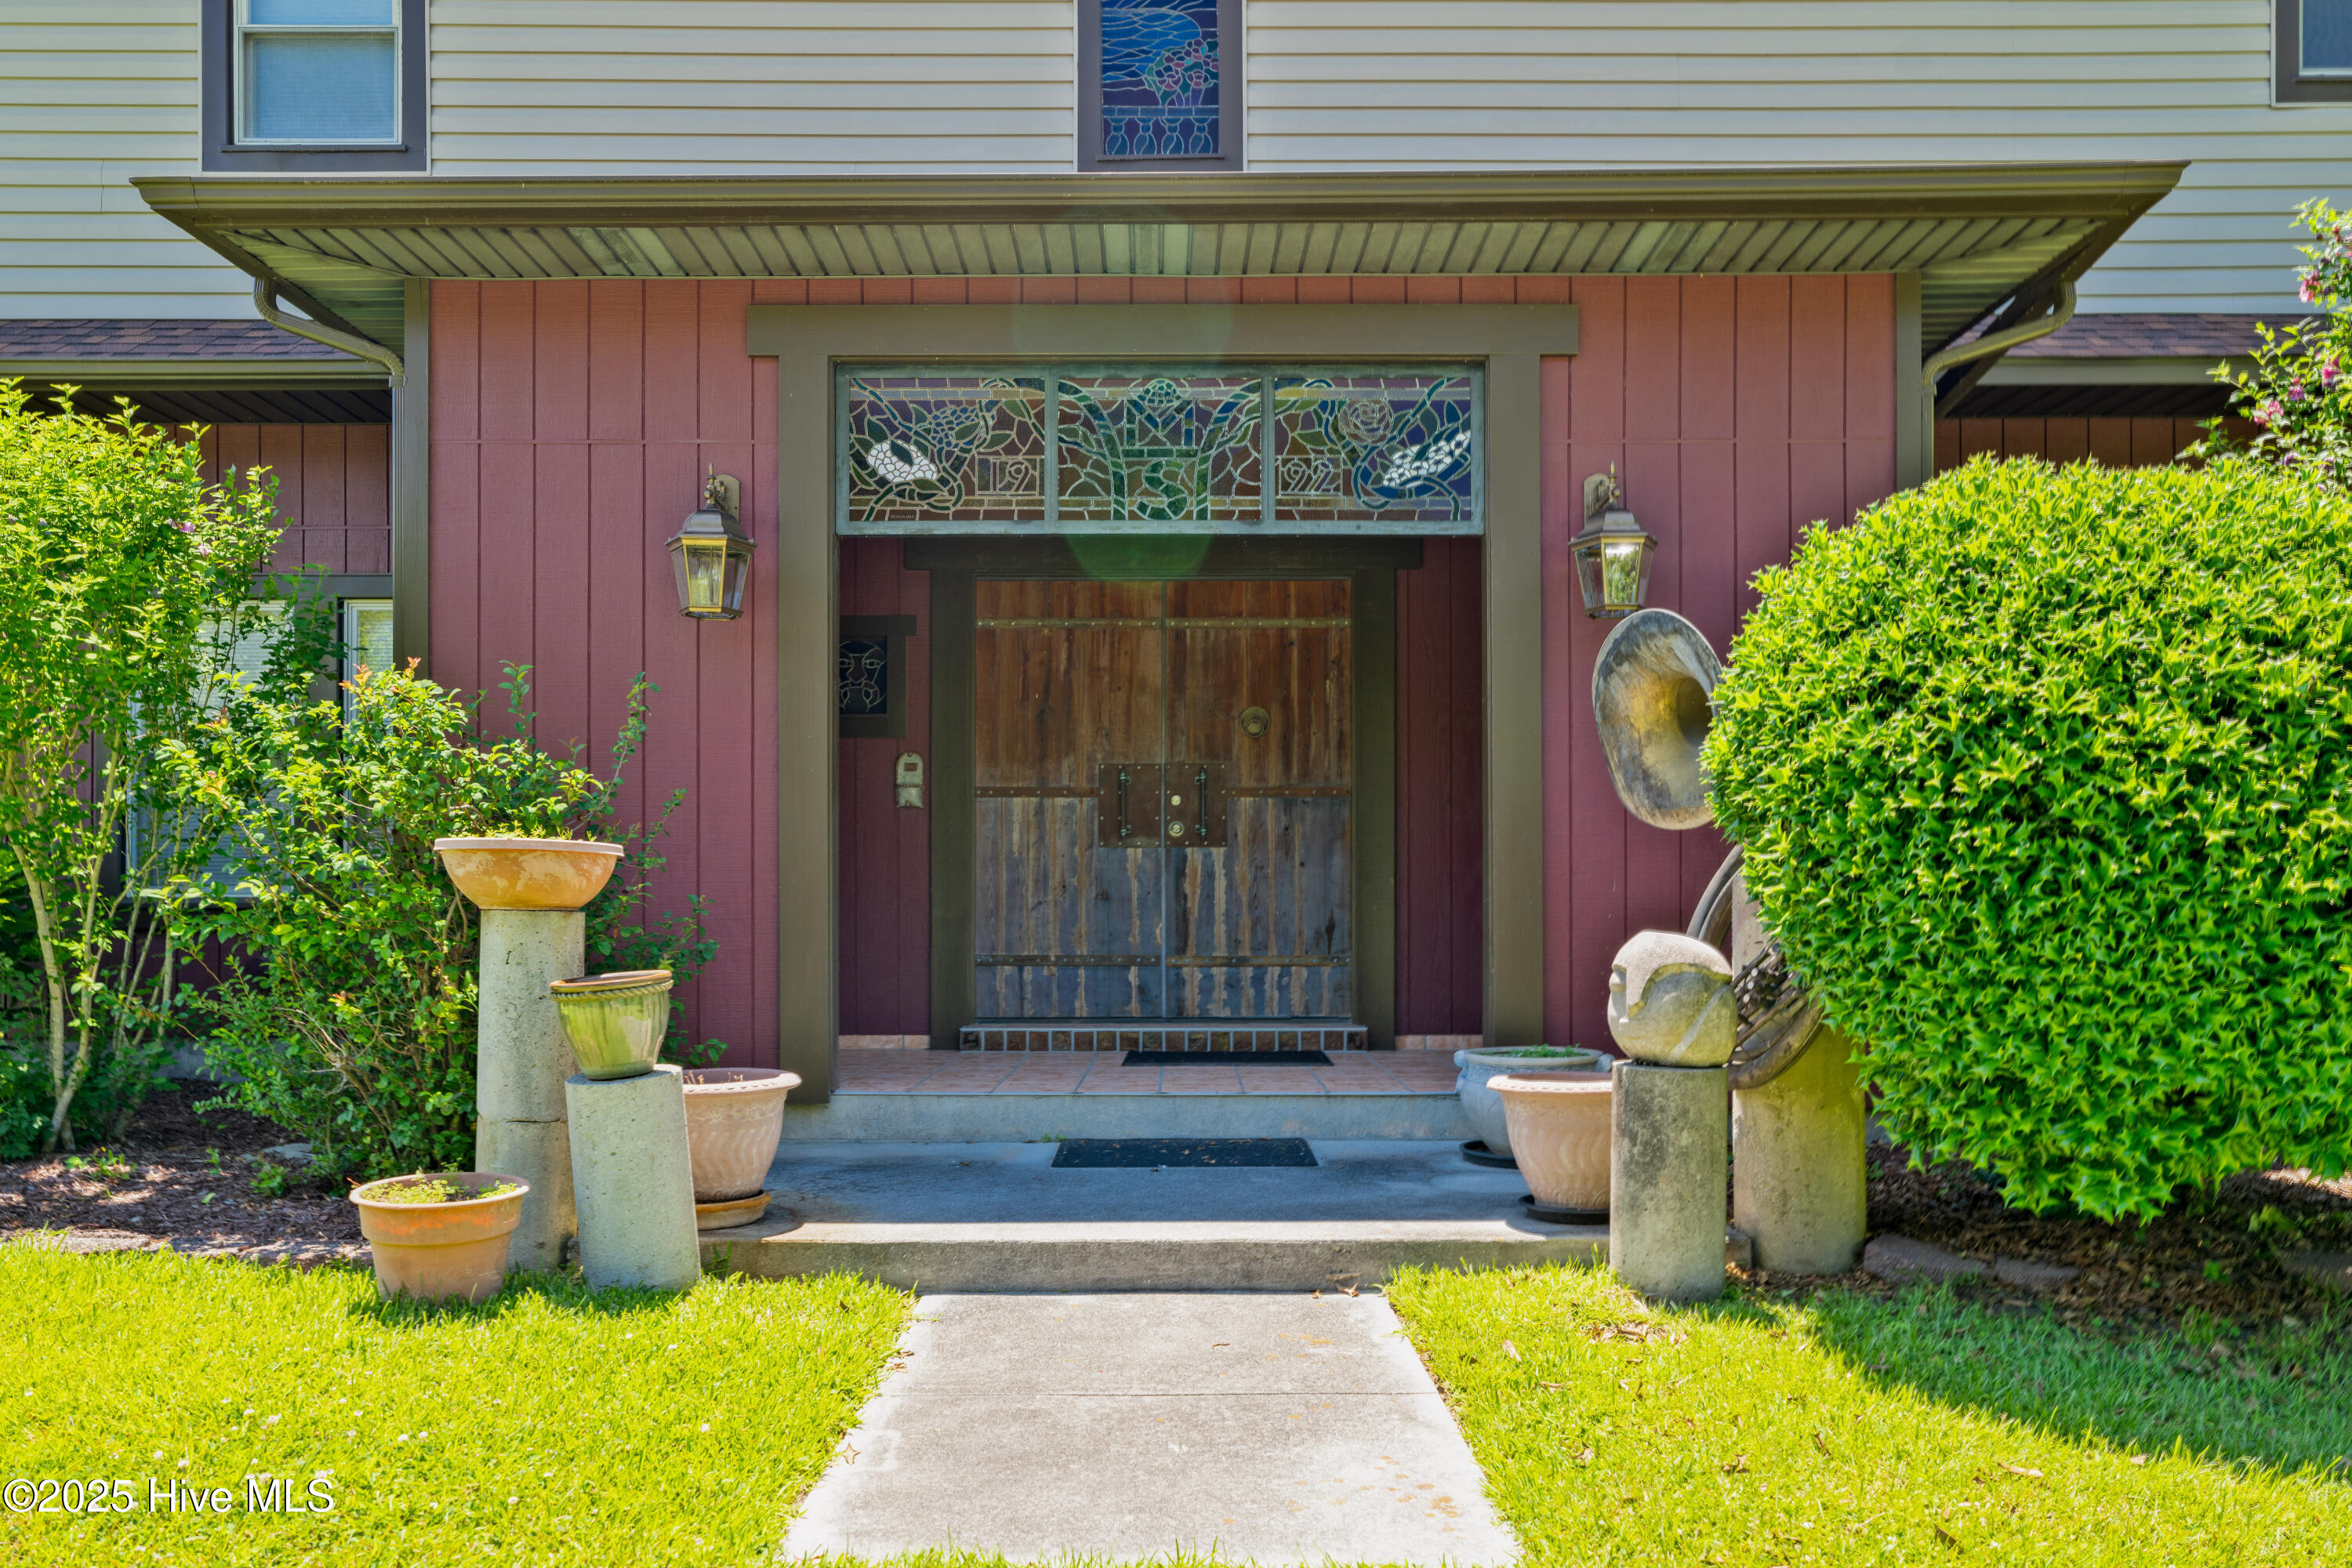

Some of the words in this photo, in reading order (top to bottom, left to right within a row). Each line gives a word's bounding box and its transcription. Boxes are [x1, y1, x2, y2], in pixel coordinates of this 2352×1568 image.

[990, 459, 1032, 492] 19
[1134, 457, 1190, 521] S
[1284, 459, 1334, 493] 92
